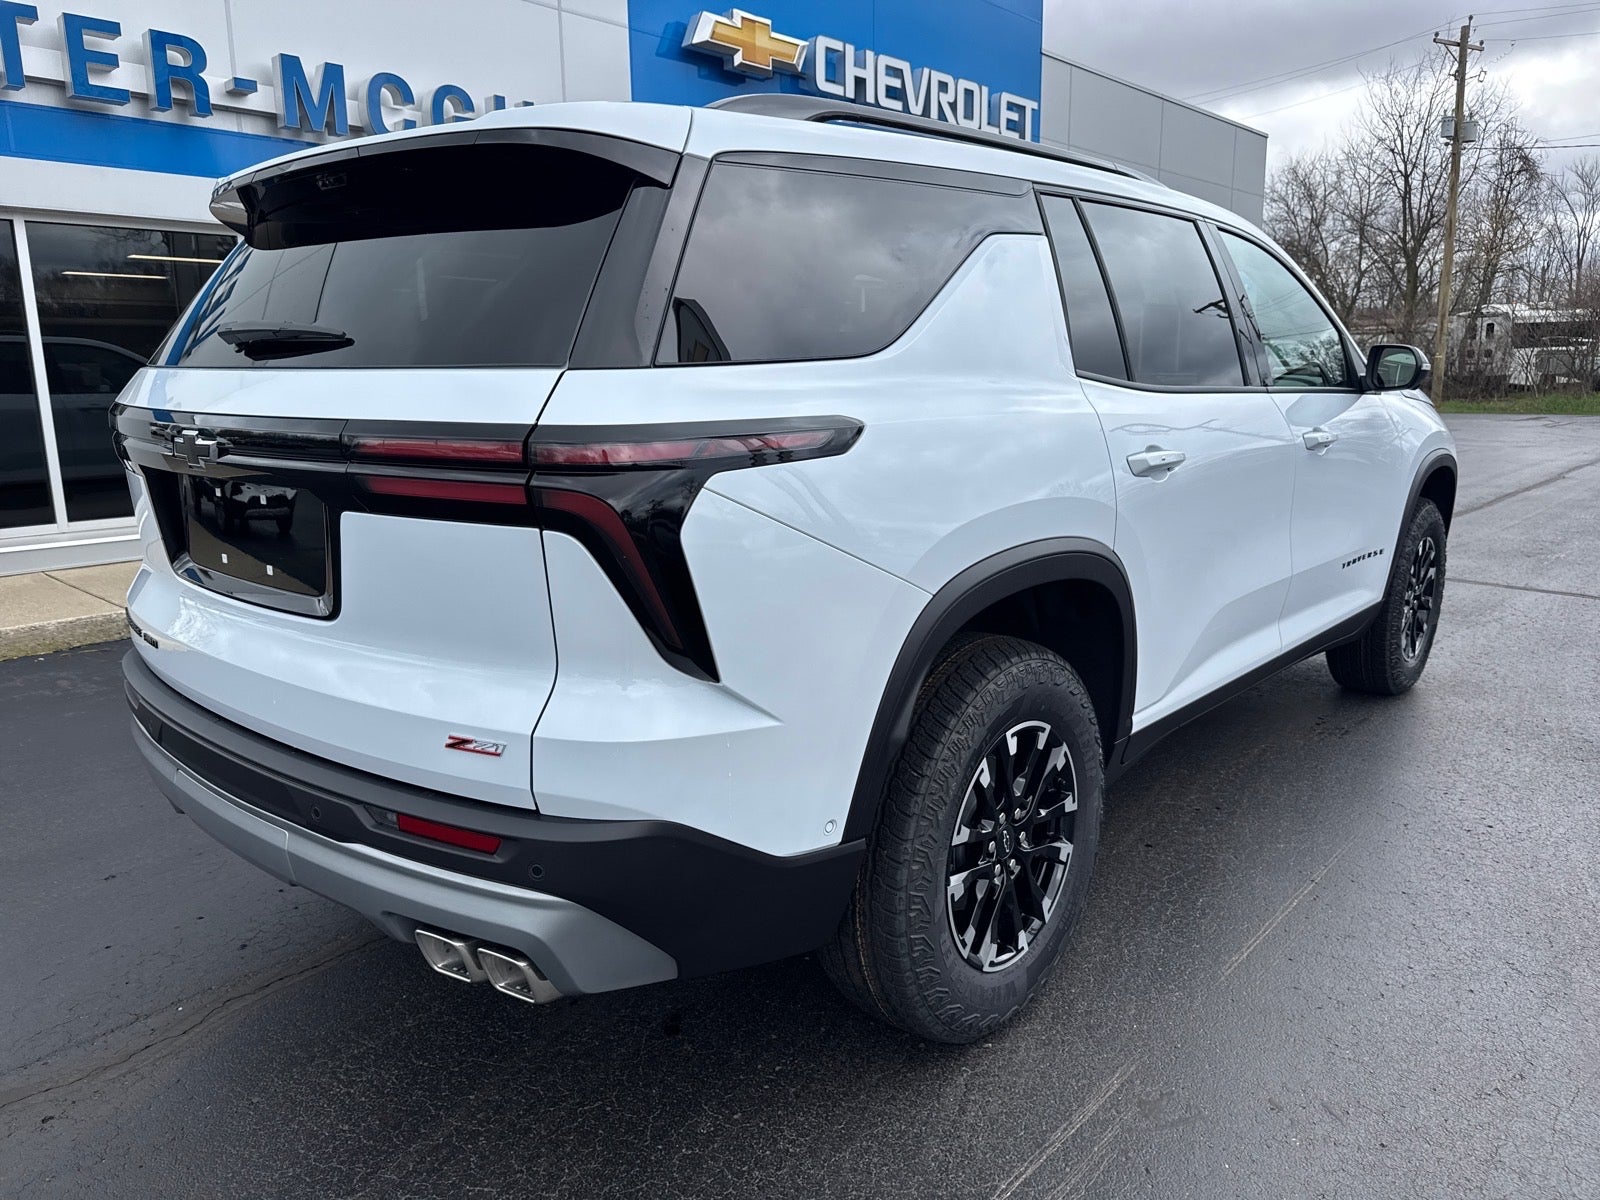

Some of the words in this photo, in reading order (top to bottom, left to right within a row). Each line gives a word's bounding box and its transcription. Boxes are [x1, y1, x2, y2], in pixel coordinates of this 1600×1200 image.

[0, 3, 535, 138] TER-MCG
[812, 35, 1039, 141] CHEVROLET
[1341, 547, 1385, 570] TRAVERSE
[444, 733, 507, 758] Z71
